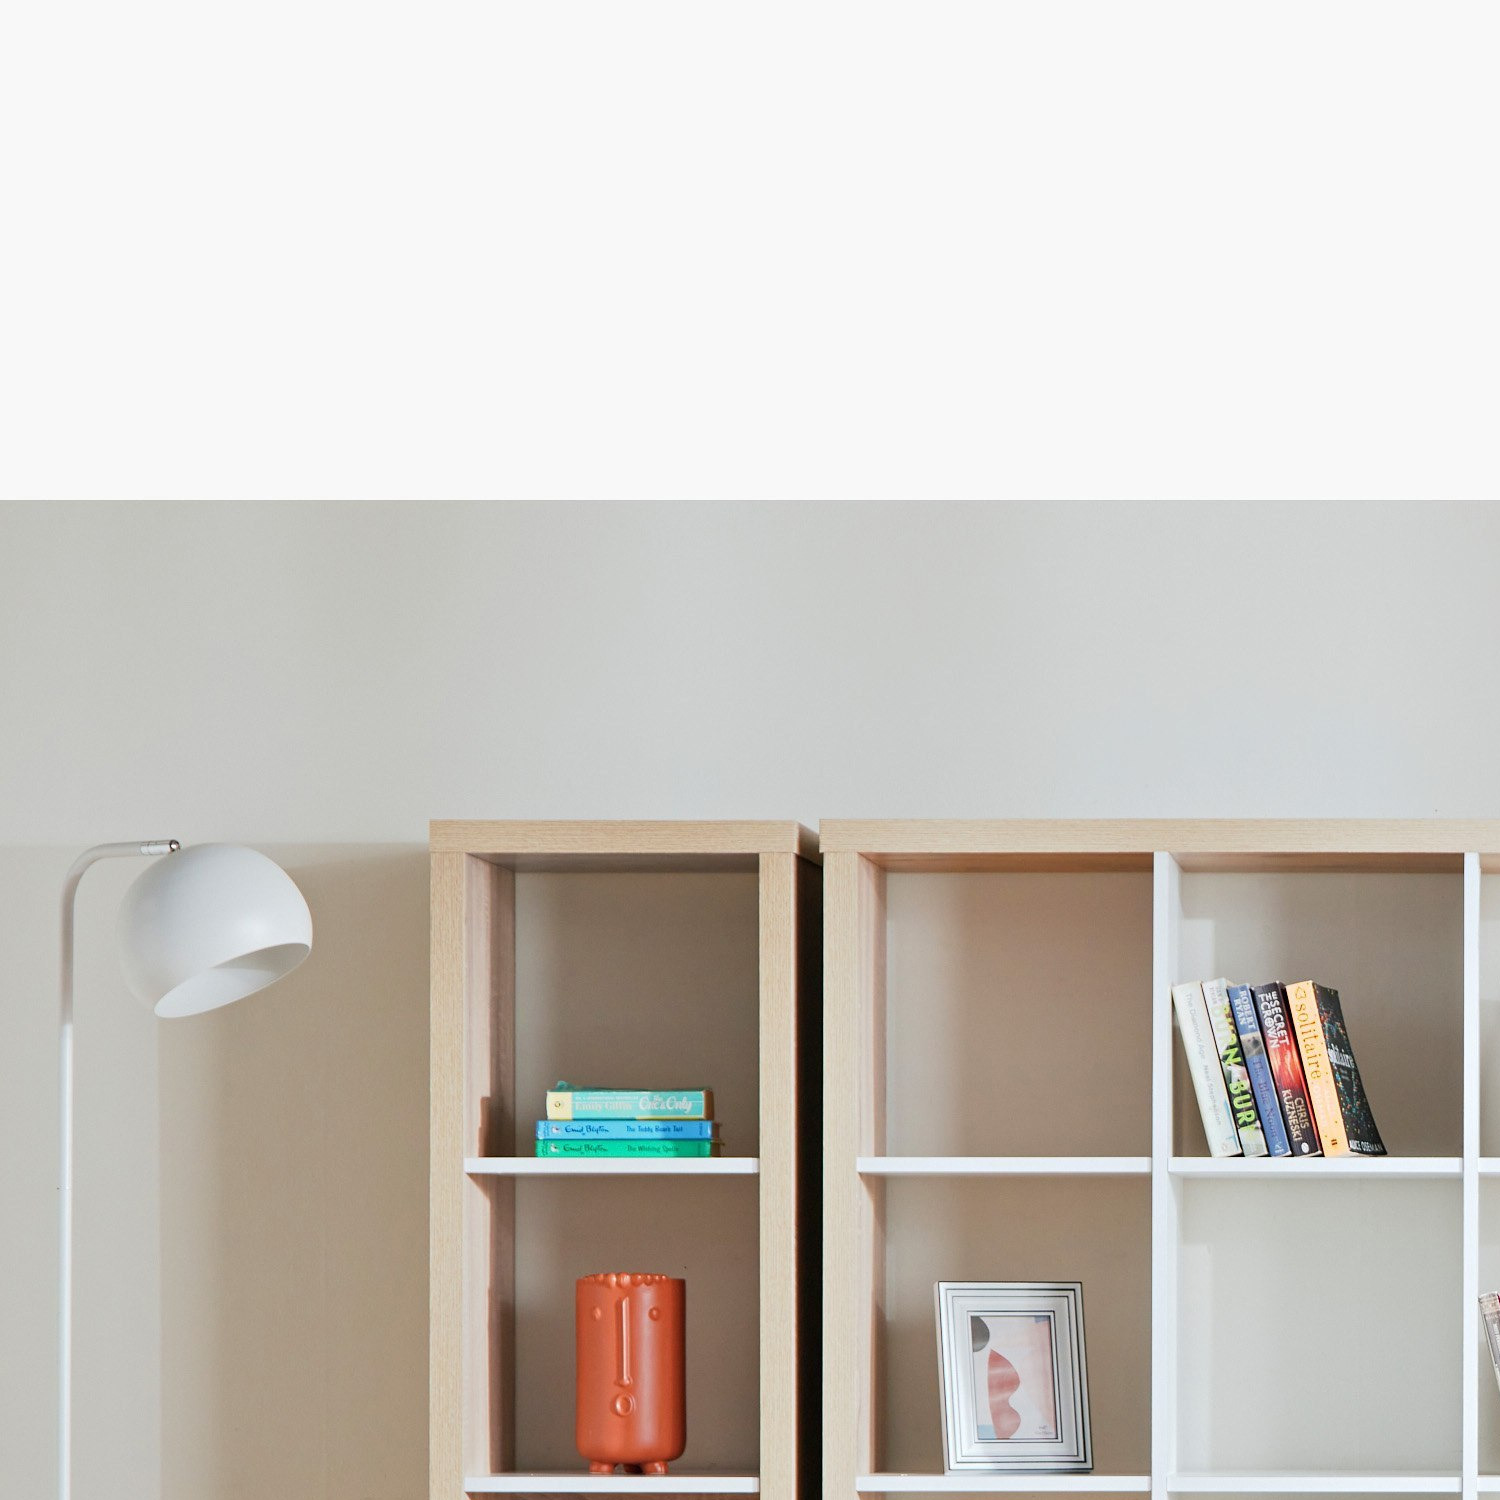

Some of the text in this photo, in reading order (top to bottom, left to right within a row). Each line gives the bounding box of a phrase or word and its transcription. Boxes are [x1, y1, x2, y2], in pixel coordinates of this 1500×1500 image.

[1234, 998, 1247, 1025] RYAN
[1239, 990, 1256, 1029] ROBERT
[1258, 991, 1278, 1002] THE
[1261, 1002, 1280, 1048] CROWN
[1270, 1000, 1290, 1046] SECRET
[1295, 1003, 1321, 1080] solitaire
[1282, 1089, 1302, 1141] KUZNESKI
[1295, 1097, 1309, 1129] CHRIS
